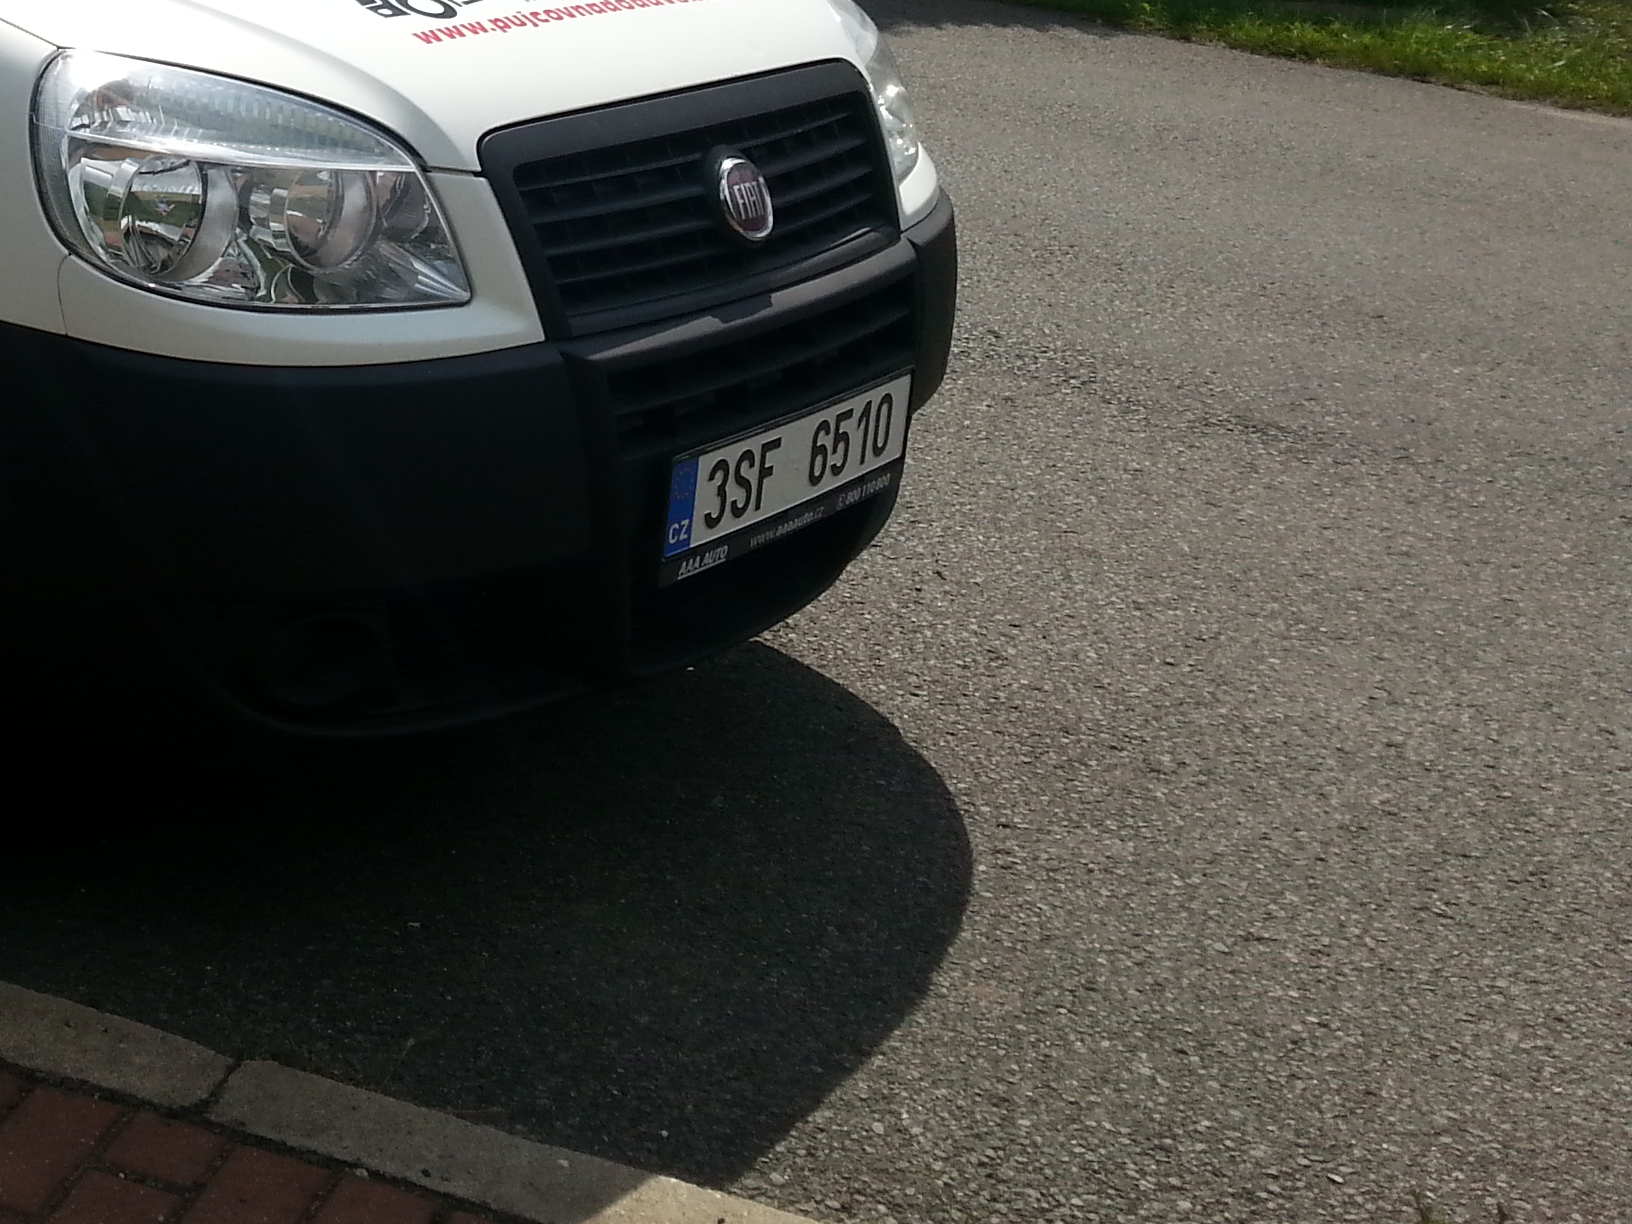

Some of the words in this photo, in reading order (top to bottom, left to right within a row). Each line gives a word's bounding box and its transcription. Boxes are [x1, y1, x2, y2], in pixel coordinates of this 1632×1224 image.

[733, 181, 765, 220] FIAT
[703, 437, 782, 529] 3SF
[808, 392, 893, 487] 6510
[668, 519, 689, 544] CZ
[678, 556, 700, 575] AAA
[701, 545, 728, 566] AUTO
